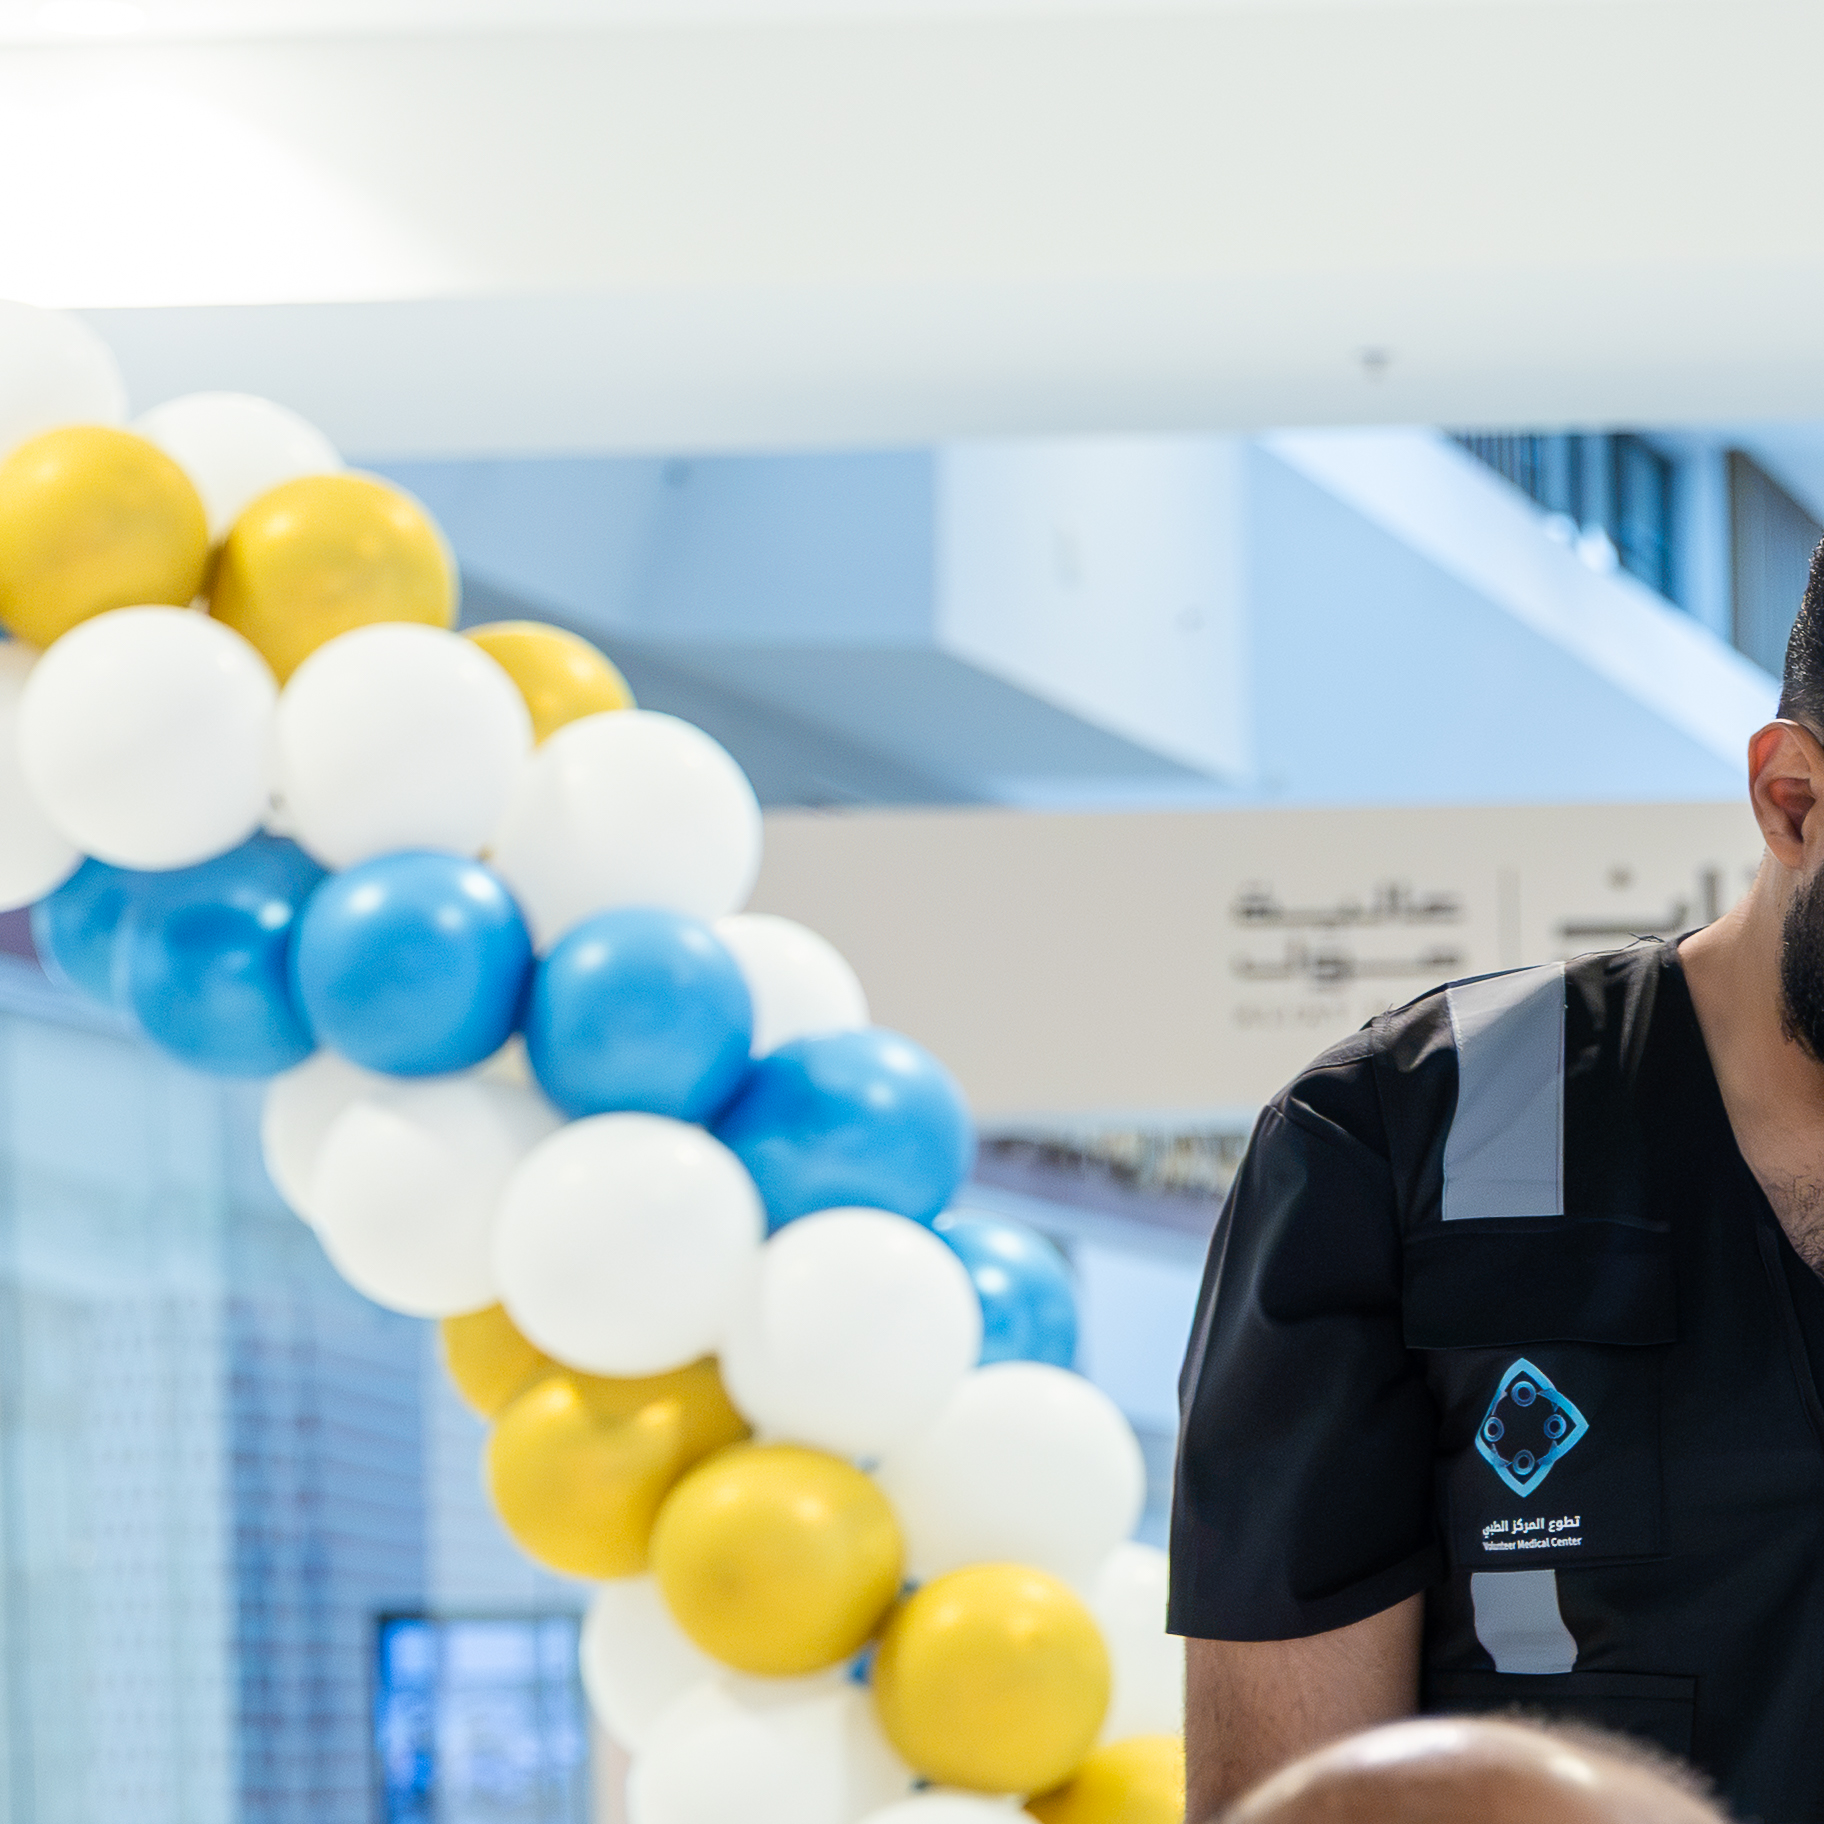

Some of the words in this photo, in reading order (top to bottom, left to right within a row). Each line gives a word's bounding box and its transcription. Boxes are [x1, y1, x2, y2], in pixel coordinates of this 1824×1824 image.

[1482, 1520, 1509, 1539] الطبي
[1511, 1518, 1545, 1534] المركز
[1548, 1516, 1581, 1532] تطوع
[1517, 1538, 1549, 1549] Medical
[1551, 1537, 1582, 1547] Center
